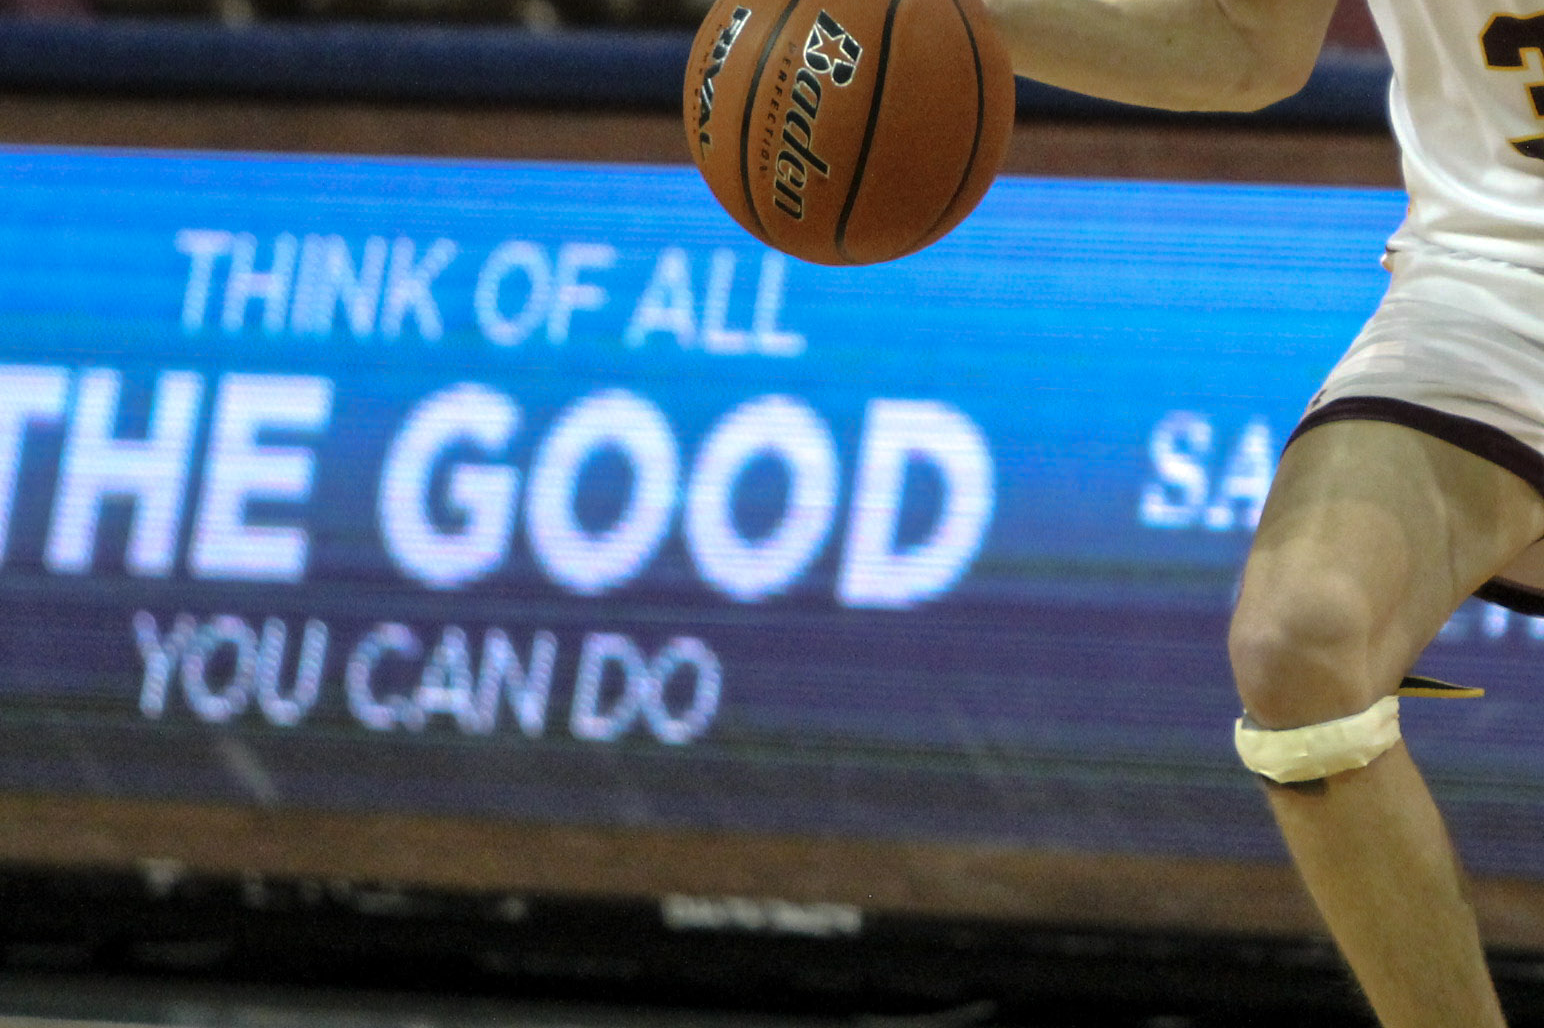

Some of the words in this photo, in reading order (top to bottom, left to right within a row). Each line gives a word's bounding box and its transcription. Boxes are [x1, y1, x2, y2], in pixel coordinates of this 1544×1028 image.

[773, 8, 863, 221] Baden
[176, 227, 458, 343] THINK
[474, 239, 617, 347] OF
[625, 246, 808, 358] ALL
[376, 382, 997, 610] GOOD
[131, 609, 330, 726] YOU
[345, 621, 558, 738] CAN
[568, 631, 724, 744] DO
